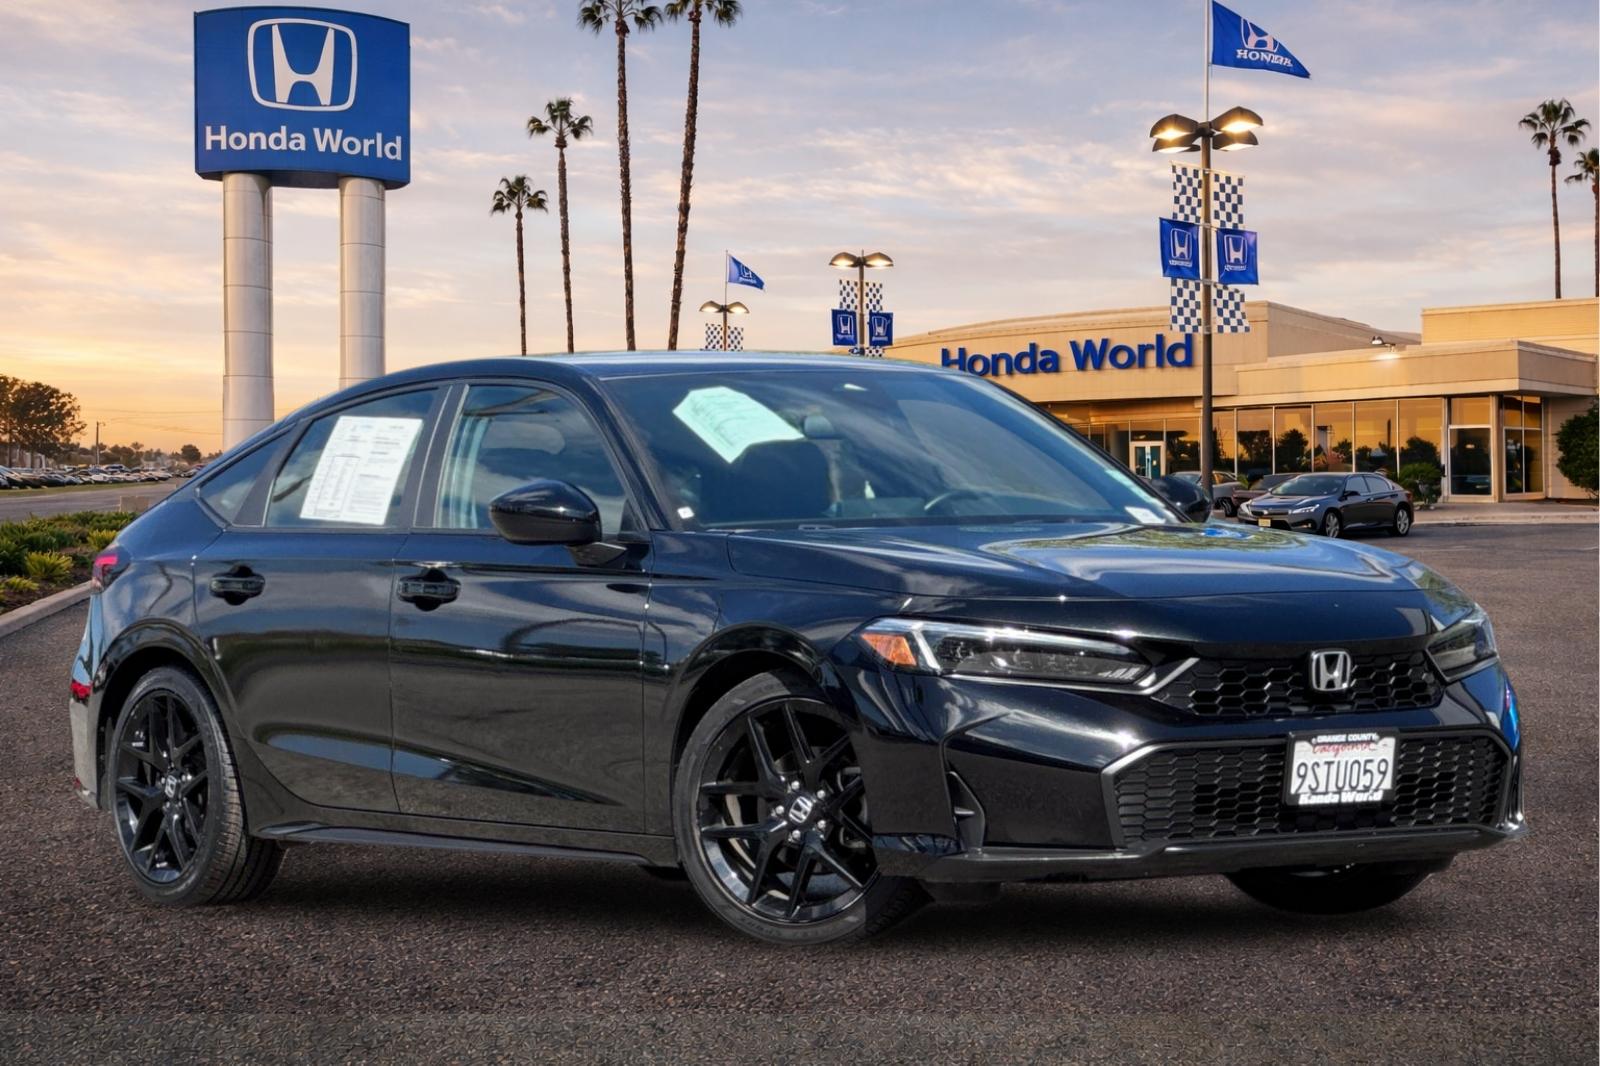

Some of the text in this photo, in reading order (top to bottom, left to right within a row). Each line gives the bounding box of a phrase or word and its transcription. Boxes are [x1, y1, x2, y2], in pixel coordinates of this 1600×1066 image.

[205, 125, 402, 161] Honda World
[941, 333, 1194, 377] Honda World
[1347, 733, 1376, 742] COUNTY
[1296, 758, 1389, 793] 9STU059
